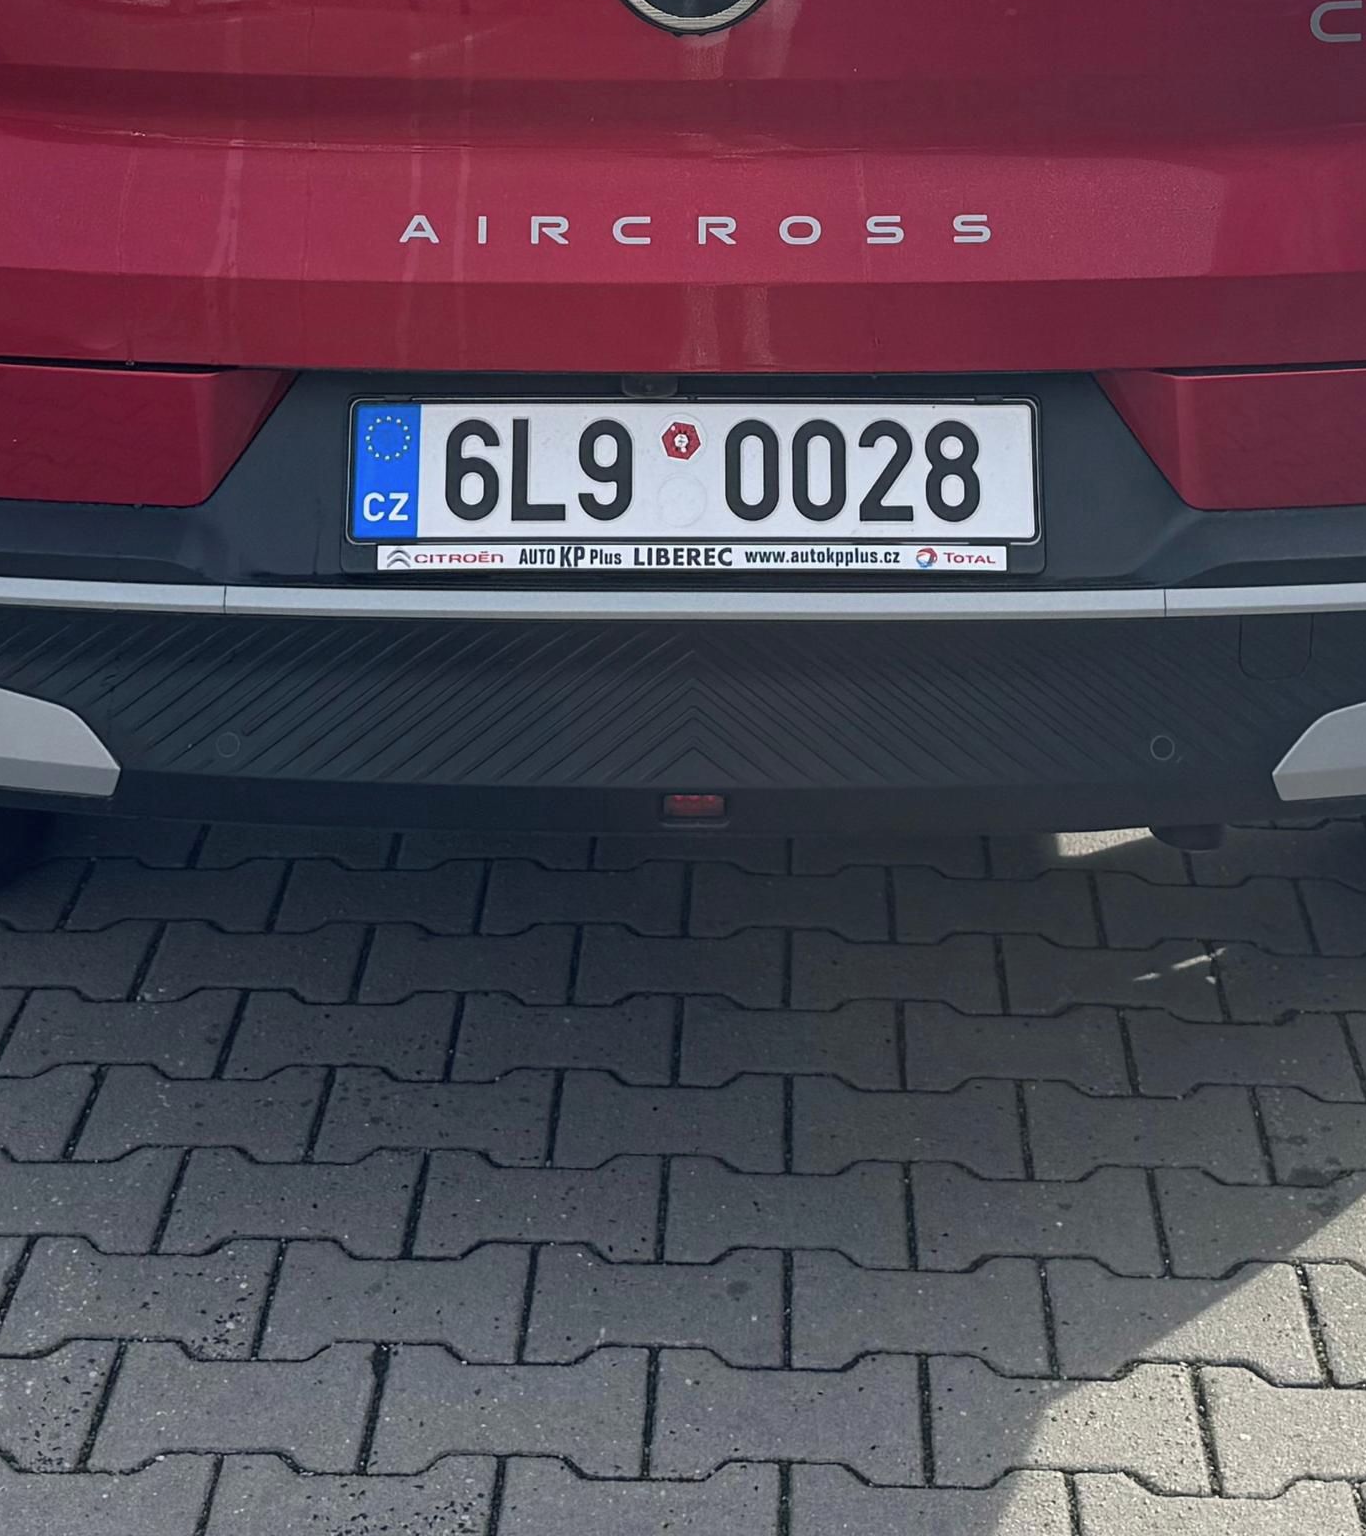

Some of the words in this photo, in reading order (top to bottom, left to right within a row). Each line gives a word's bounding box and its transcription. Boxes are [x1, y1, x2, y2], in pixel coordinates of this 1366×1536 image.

[399, 214, 993, 246] AIRCROSS
[443, 418, 634, 522] 6L9
[724, 419, 981, 522] 0028
[363, 491, 409, 522] CZ
[519, 547, 555, 565] AUTO
[560, 545, 585, 567] KP
[590, 548, 622, 565] Plus
[634, 546, 733, 566] LIBEREC
[744, 546, 901, 567] www.autokpplus.cz
[943, 551, 996, 564] TOTAL
